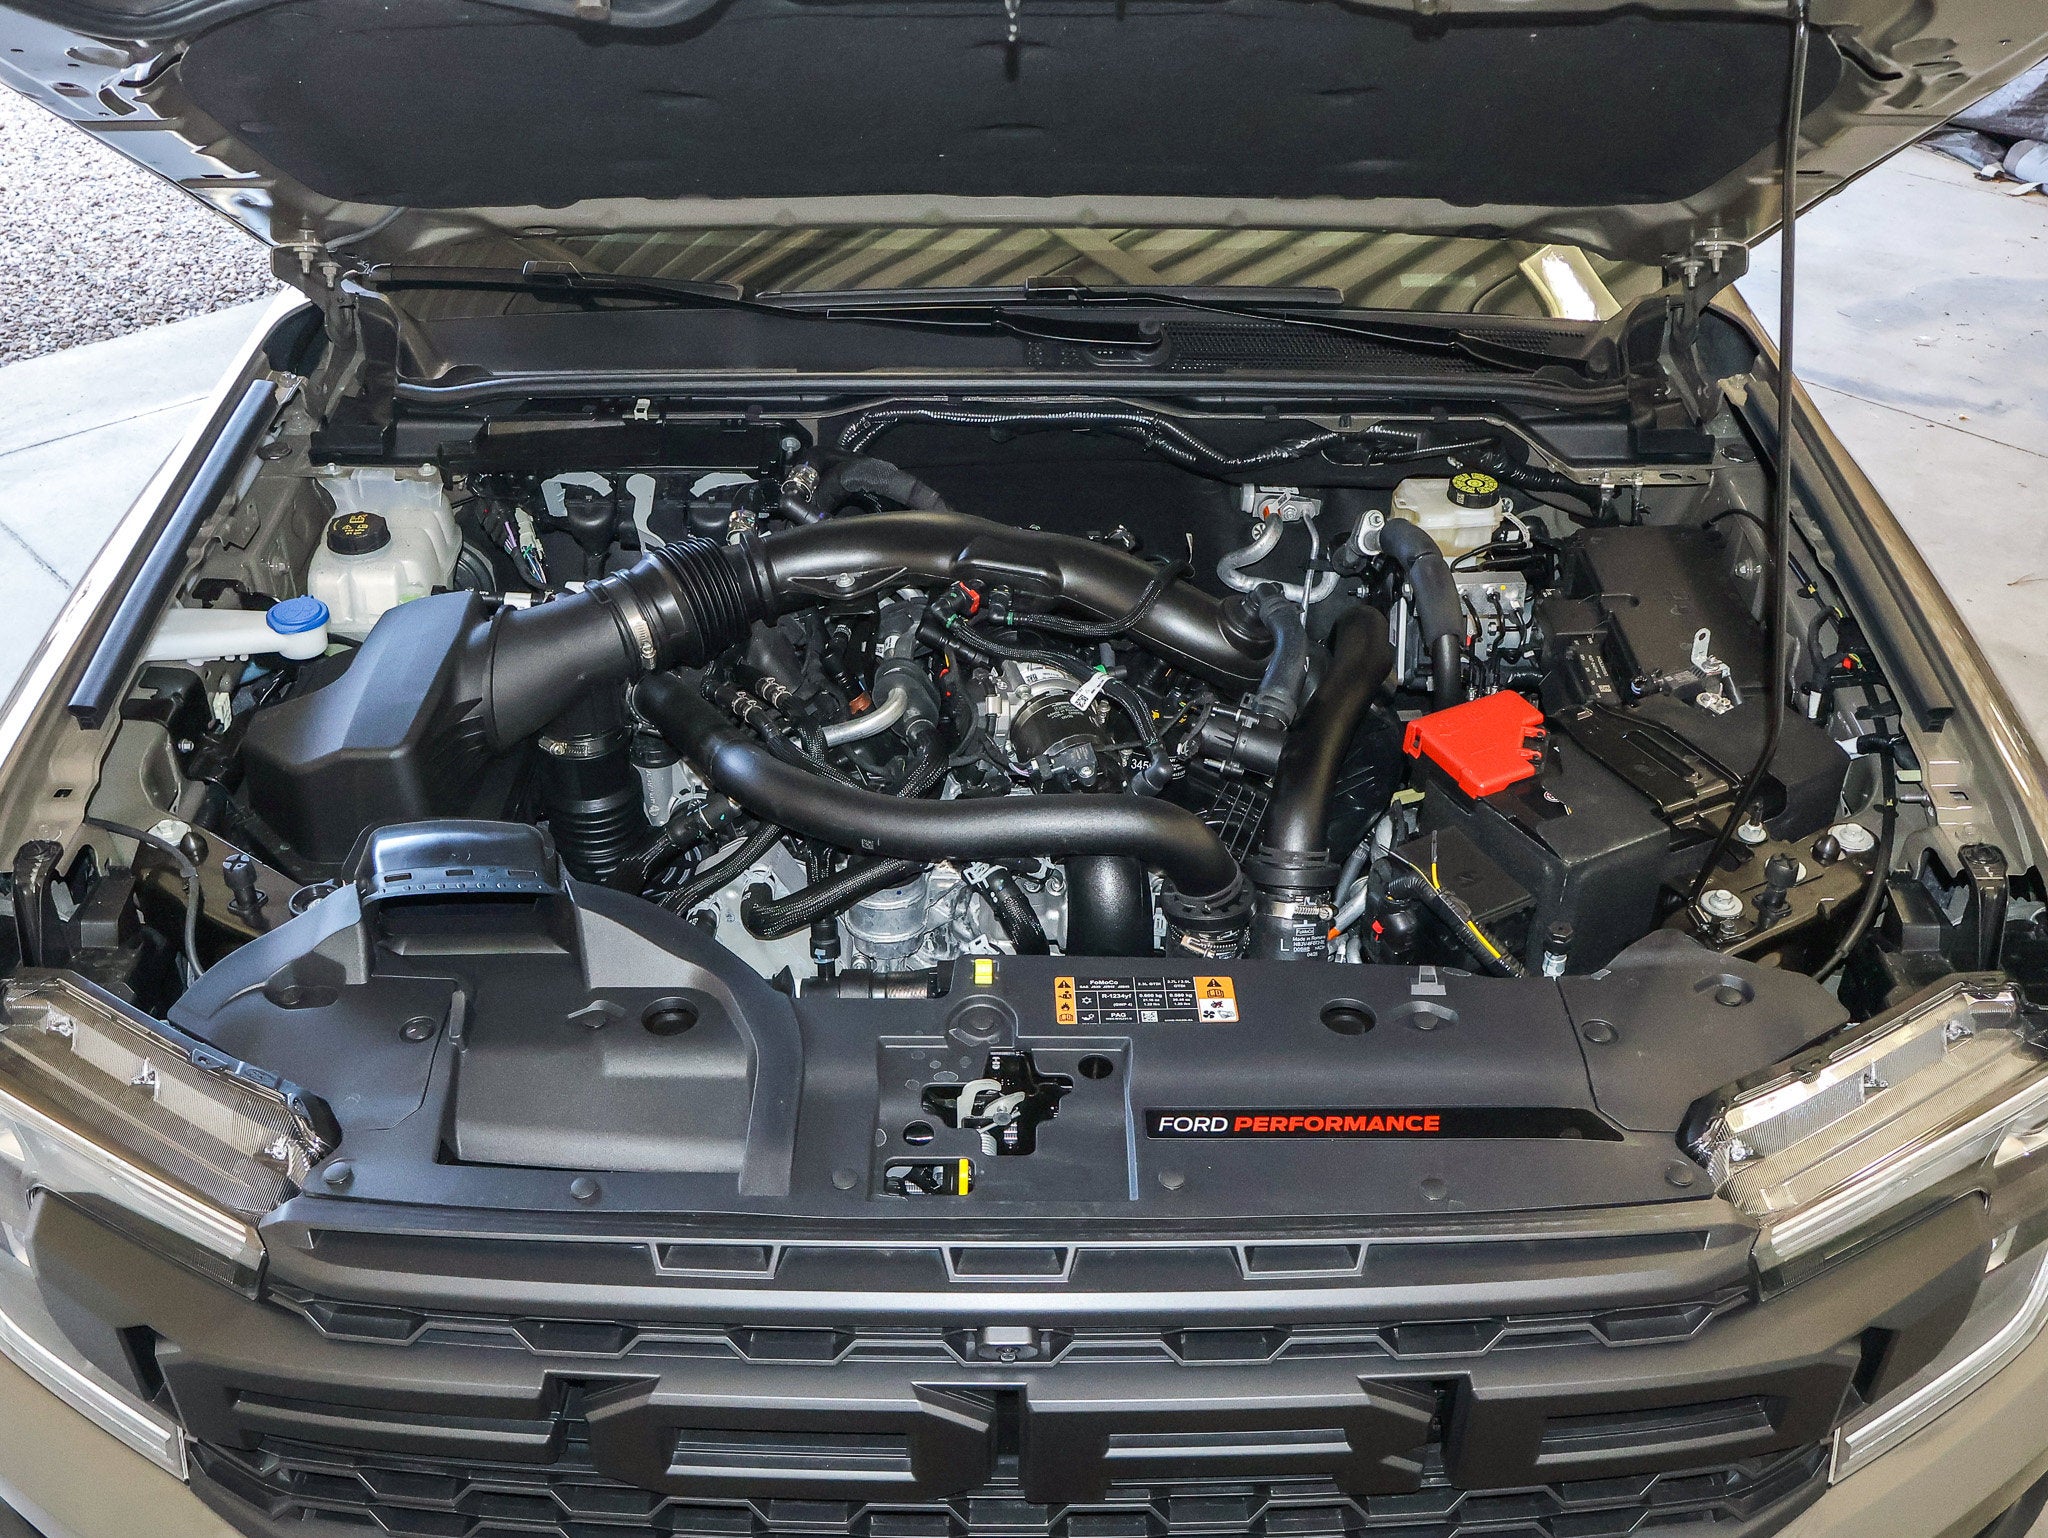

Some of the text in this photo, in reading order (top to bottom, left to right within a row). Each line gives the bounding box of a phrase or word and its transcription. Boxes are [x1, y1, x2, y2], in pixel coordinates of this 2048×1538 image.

[1280, 938, 1290, 951] L
[1159, 1115, 1440, 1132] FORD PERFORMANCE
